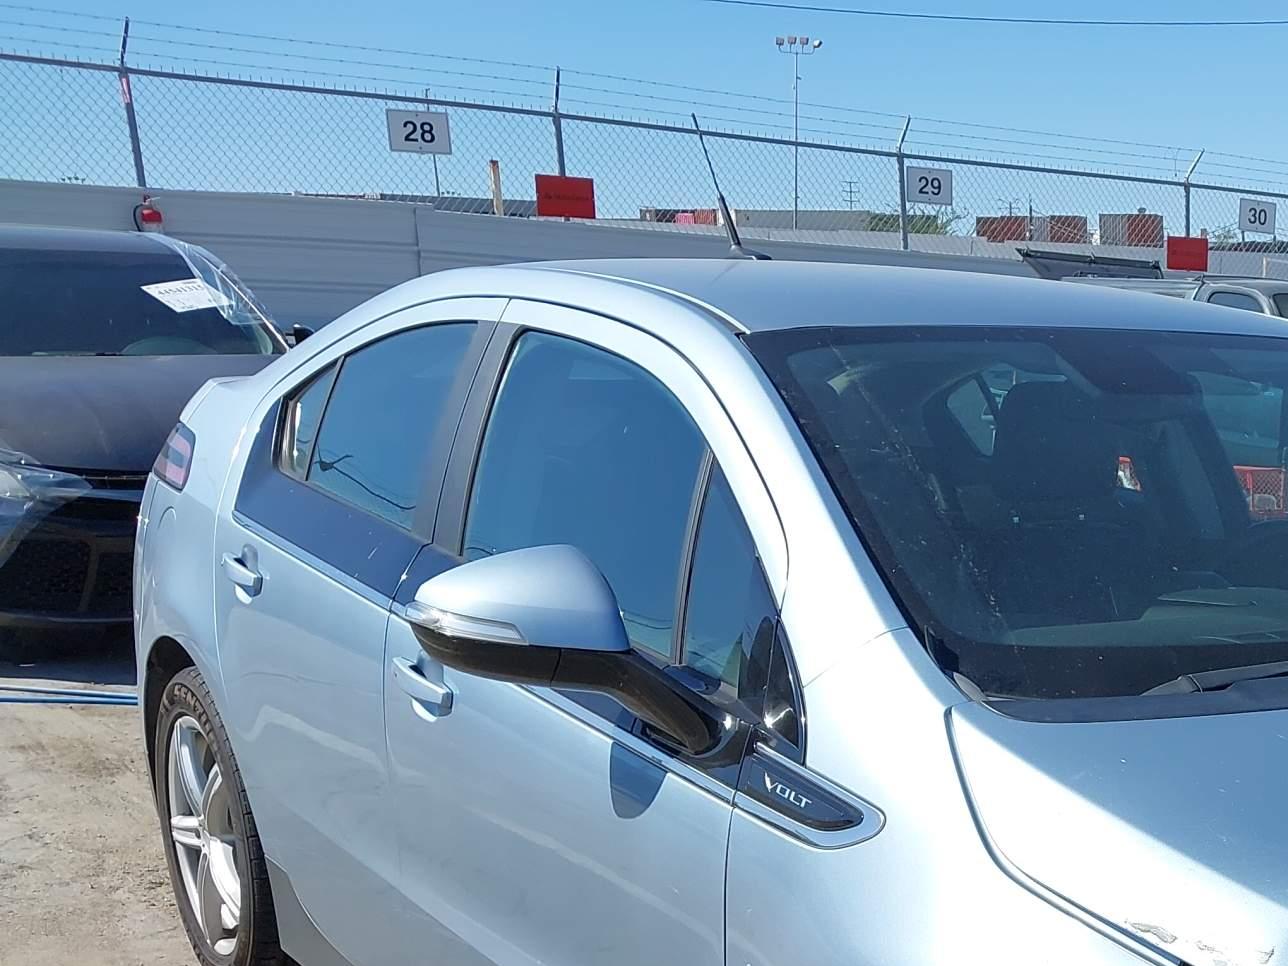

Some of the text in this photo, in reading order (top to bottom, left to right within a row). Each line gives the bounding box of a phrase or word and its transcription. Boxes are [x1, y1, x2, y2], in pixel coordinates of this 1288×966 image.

[402, 120, 436, 143] 28
[918, 176, 941, 196] 29
[1248, 207, 1268, 226] 30
[764, 770, 813, 809] VOLT
